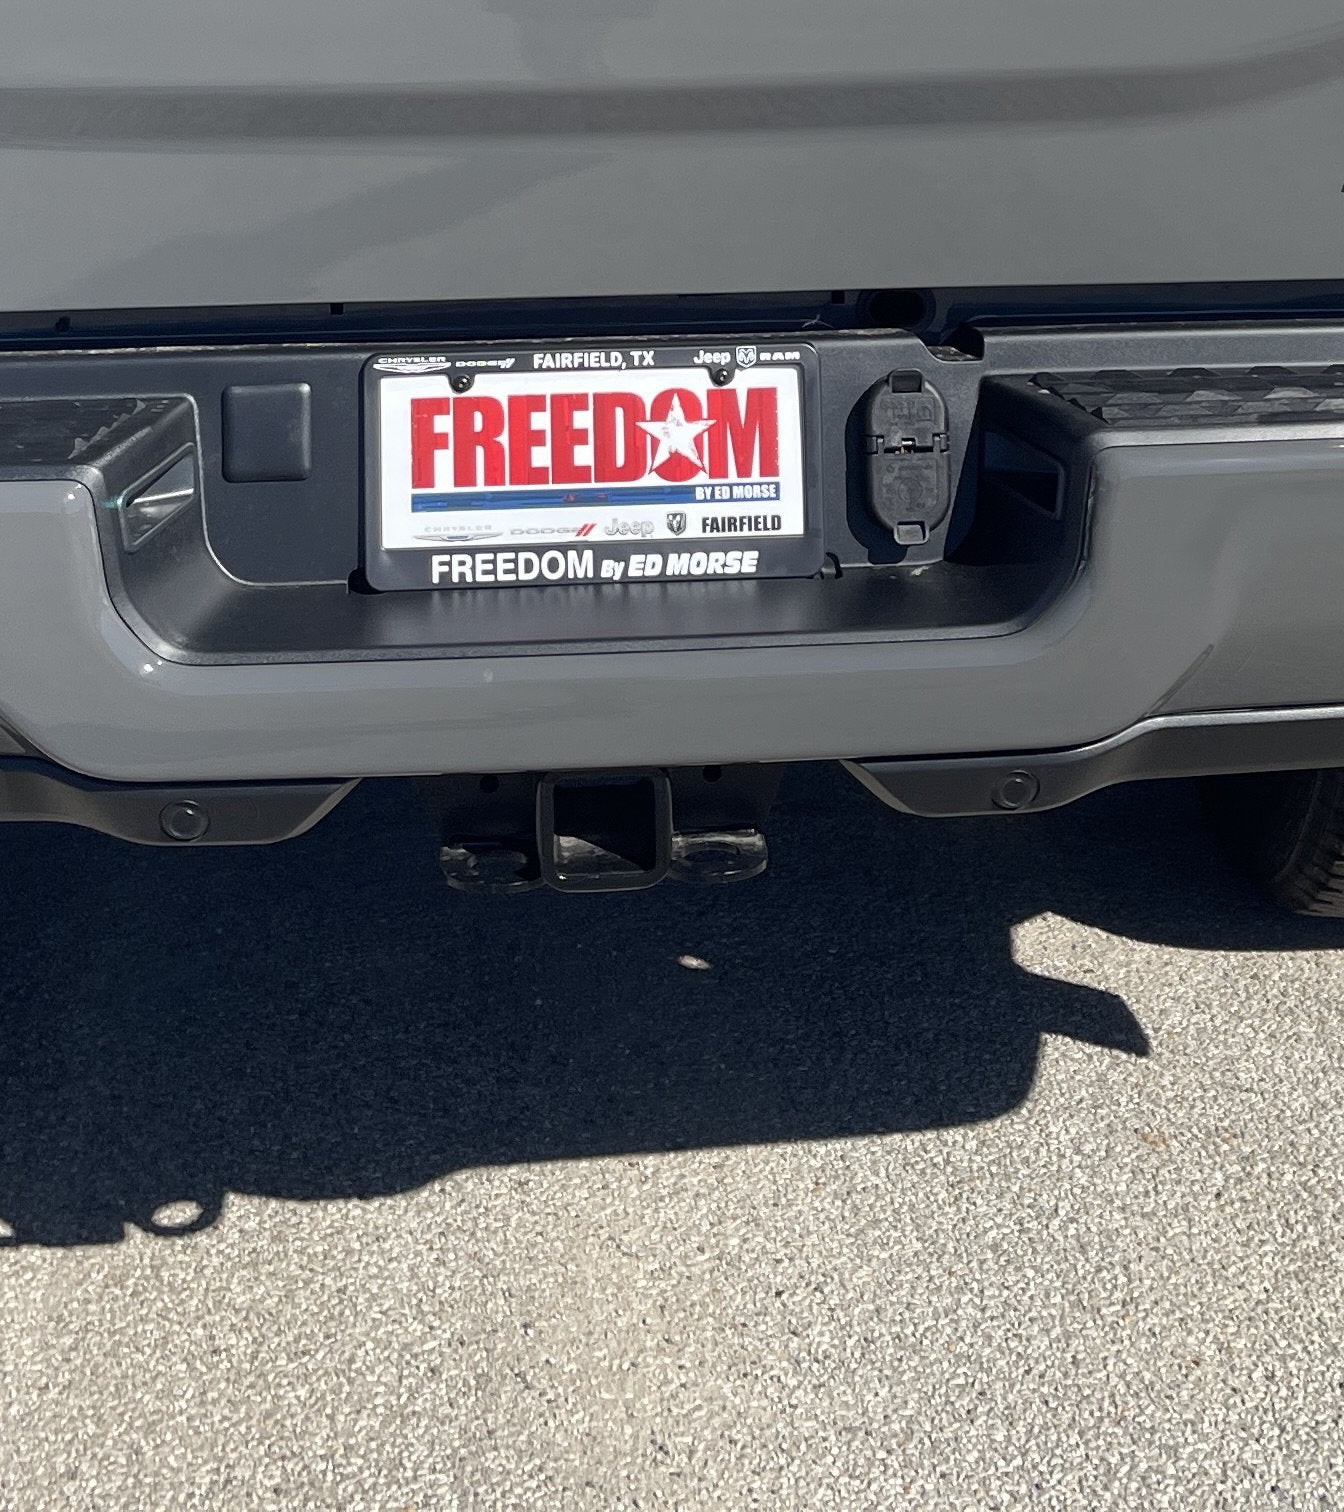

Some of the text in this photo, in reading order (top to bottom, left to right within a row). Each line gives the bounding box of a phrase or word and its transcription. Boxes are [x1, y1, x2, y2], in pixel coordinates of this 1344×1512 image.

[378, 356, 447, 364] CHRYSLER
[533, 350, 655, 369] FAIRFIELD, TX
[693, 349, 731, 366] Jeep
[759, 351, 801, 361] RAM
[411, 387, 780, 489] FREEDOM
[695, 484, 776, 500] BY ED MORSE
[424, 525, 492, 533] CHRYSLER
[605, 518, 655, 538] Jeep
[702, 515, 782, 533] FAIRFIELD
[431, 549, 759, 584] FREEDOM By ED MORSE
